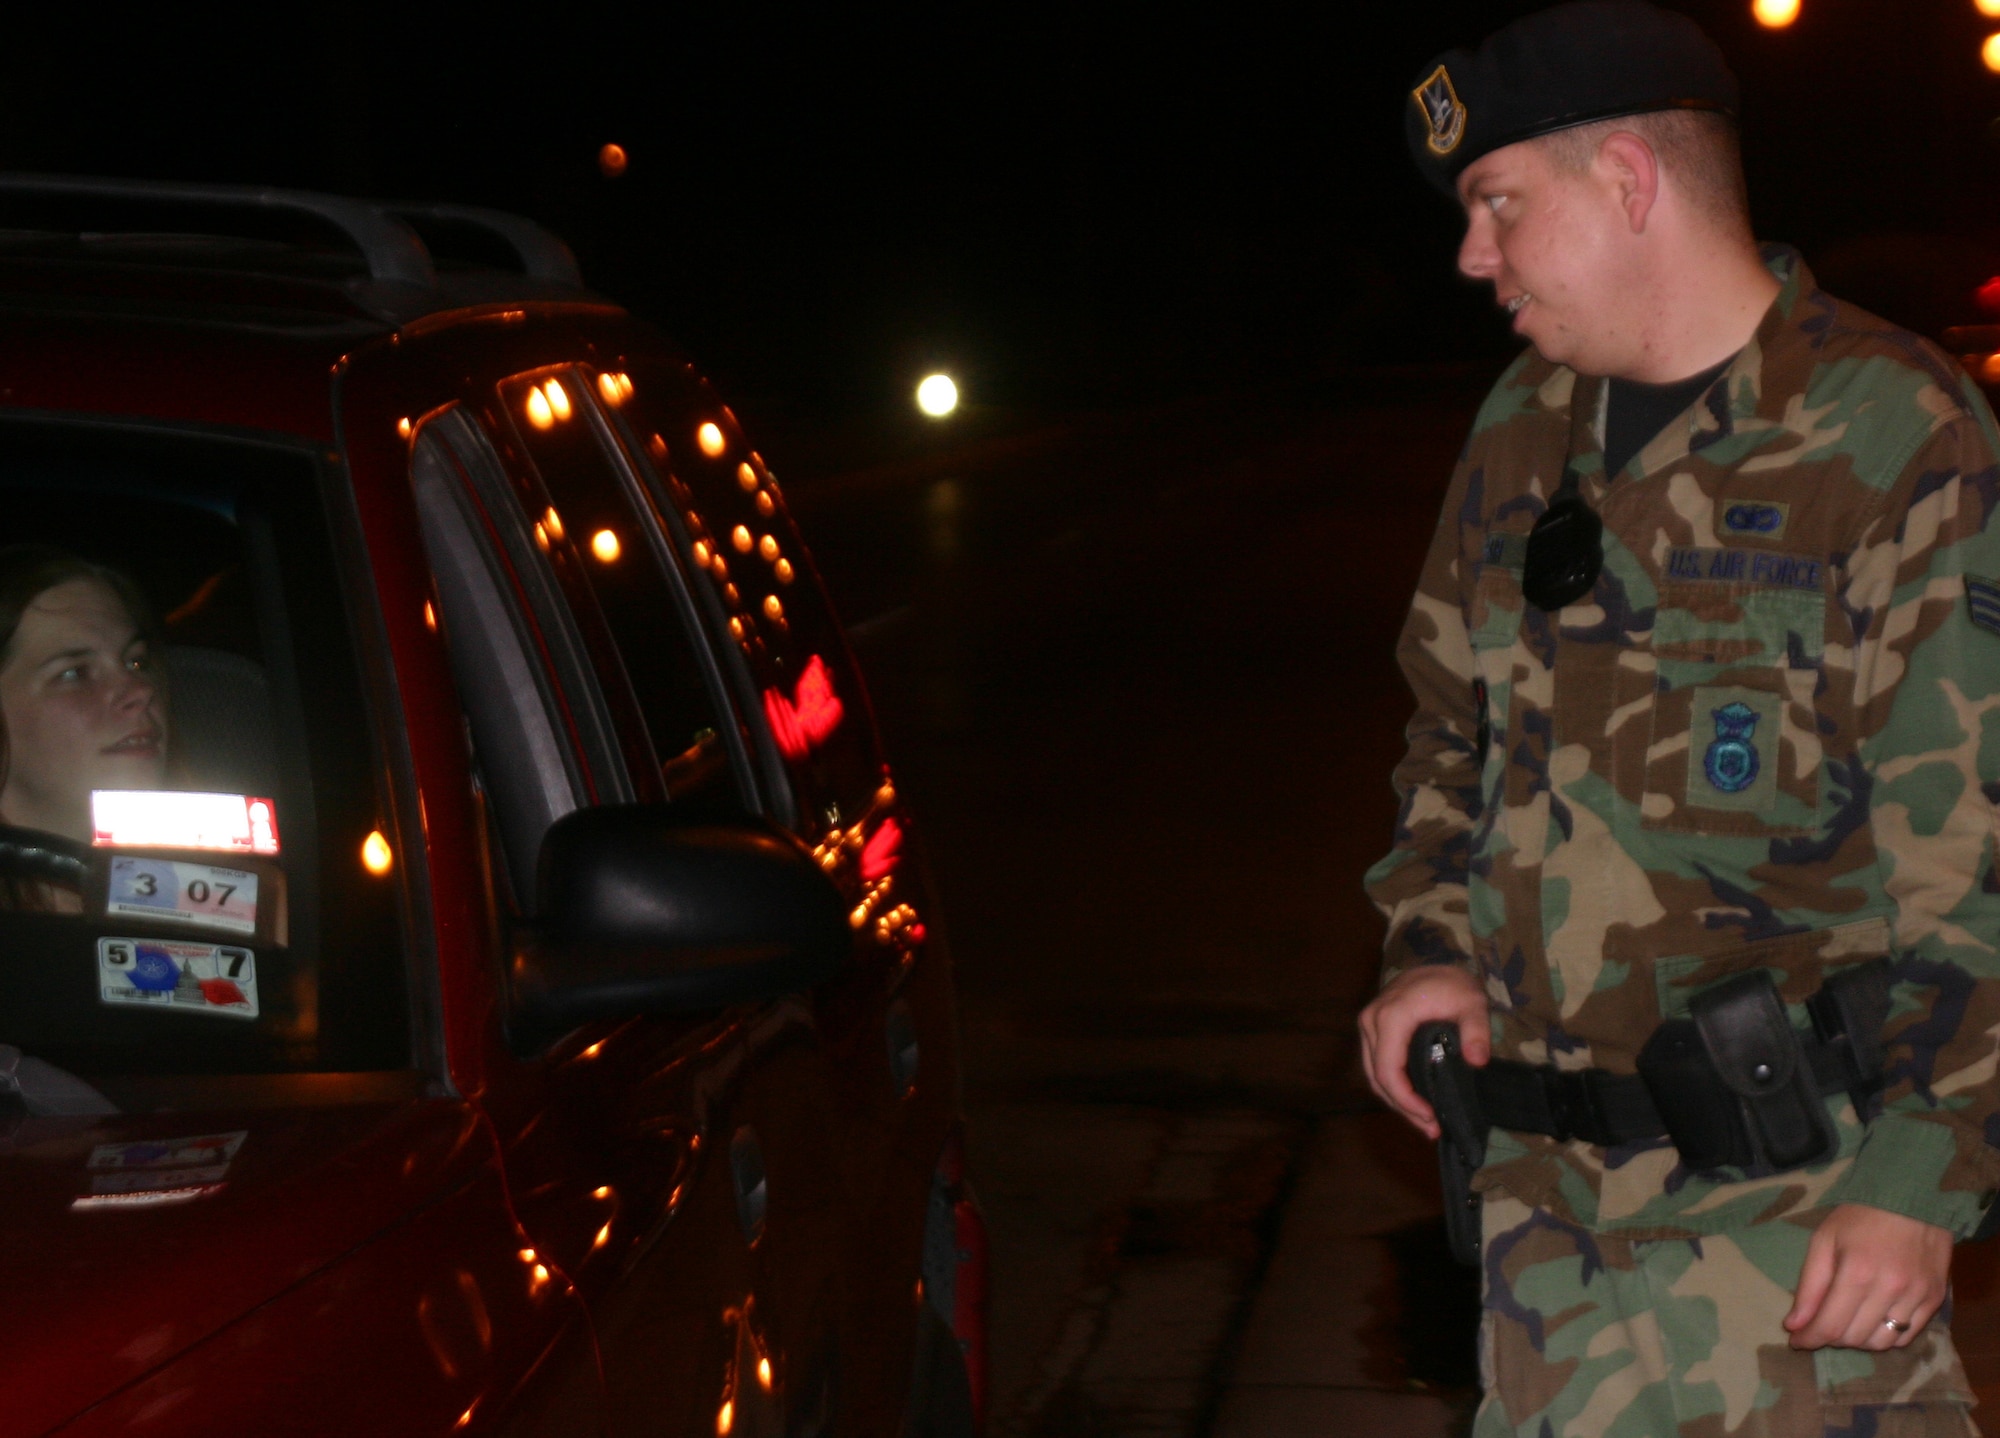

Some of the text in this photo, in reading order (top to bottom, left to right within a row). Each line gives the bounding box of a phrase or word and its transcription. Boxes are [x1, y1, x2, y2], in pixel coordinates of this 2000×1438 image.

[1668, 549, 1822, 590] U.S. AIR FORCE
[134, 872, 239, 907] 3 07
[107, 944, 129, 965] 5
[220, 949, 247, 978] 7
